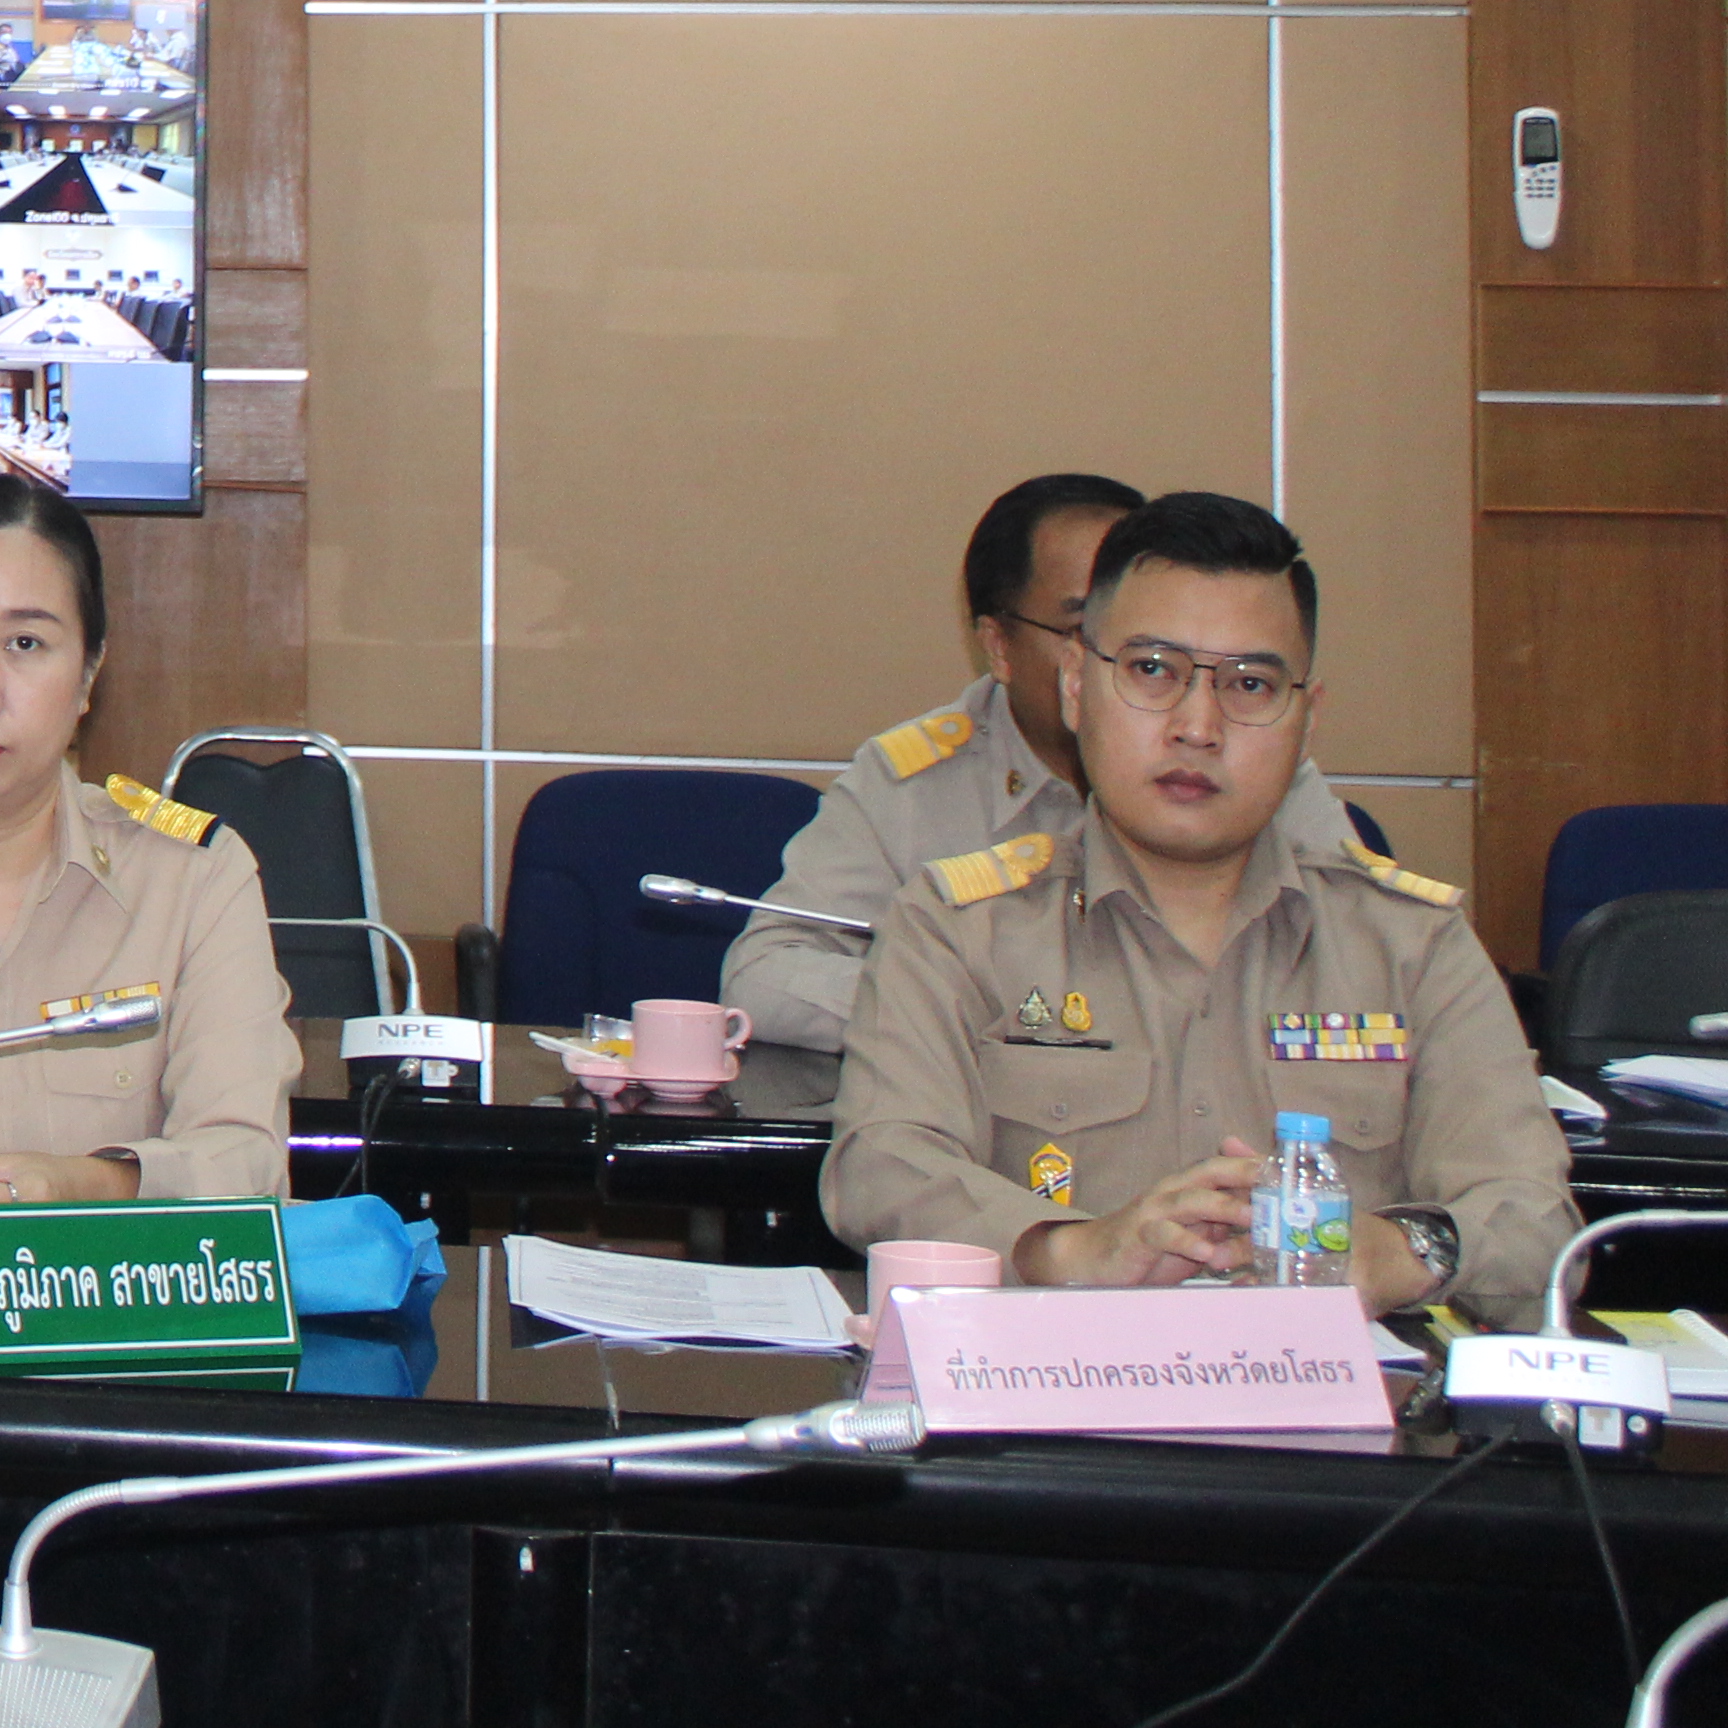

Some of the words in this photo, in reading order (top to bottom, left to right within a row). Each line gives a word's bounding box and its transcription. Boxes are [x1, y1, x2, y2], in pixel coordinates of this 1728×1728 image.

[377, 1023, 444, 1038] NPE
[111, 1238, 275, 1306] สาขายโสธร
[946, 1348, 1356, 1391] ที่ทำการปกครองจังหวัดยโสธร
[1508, 1348, 1610, 1375] NPE
